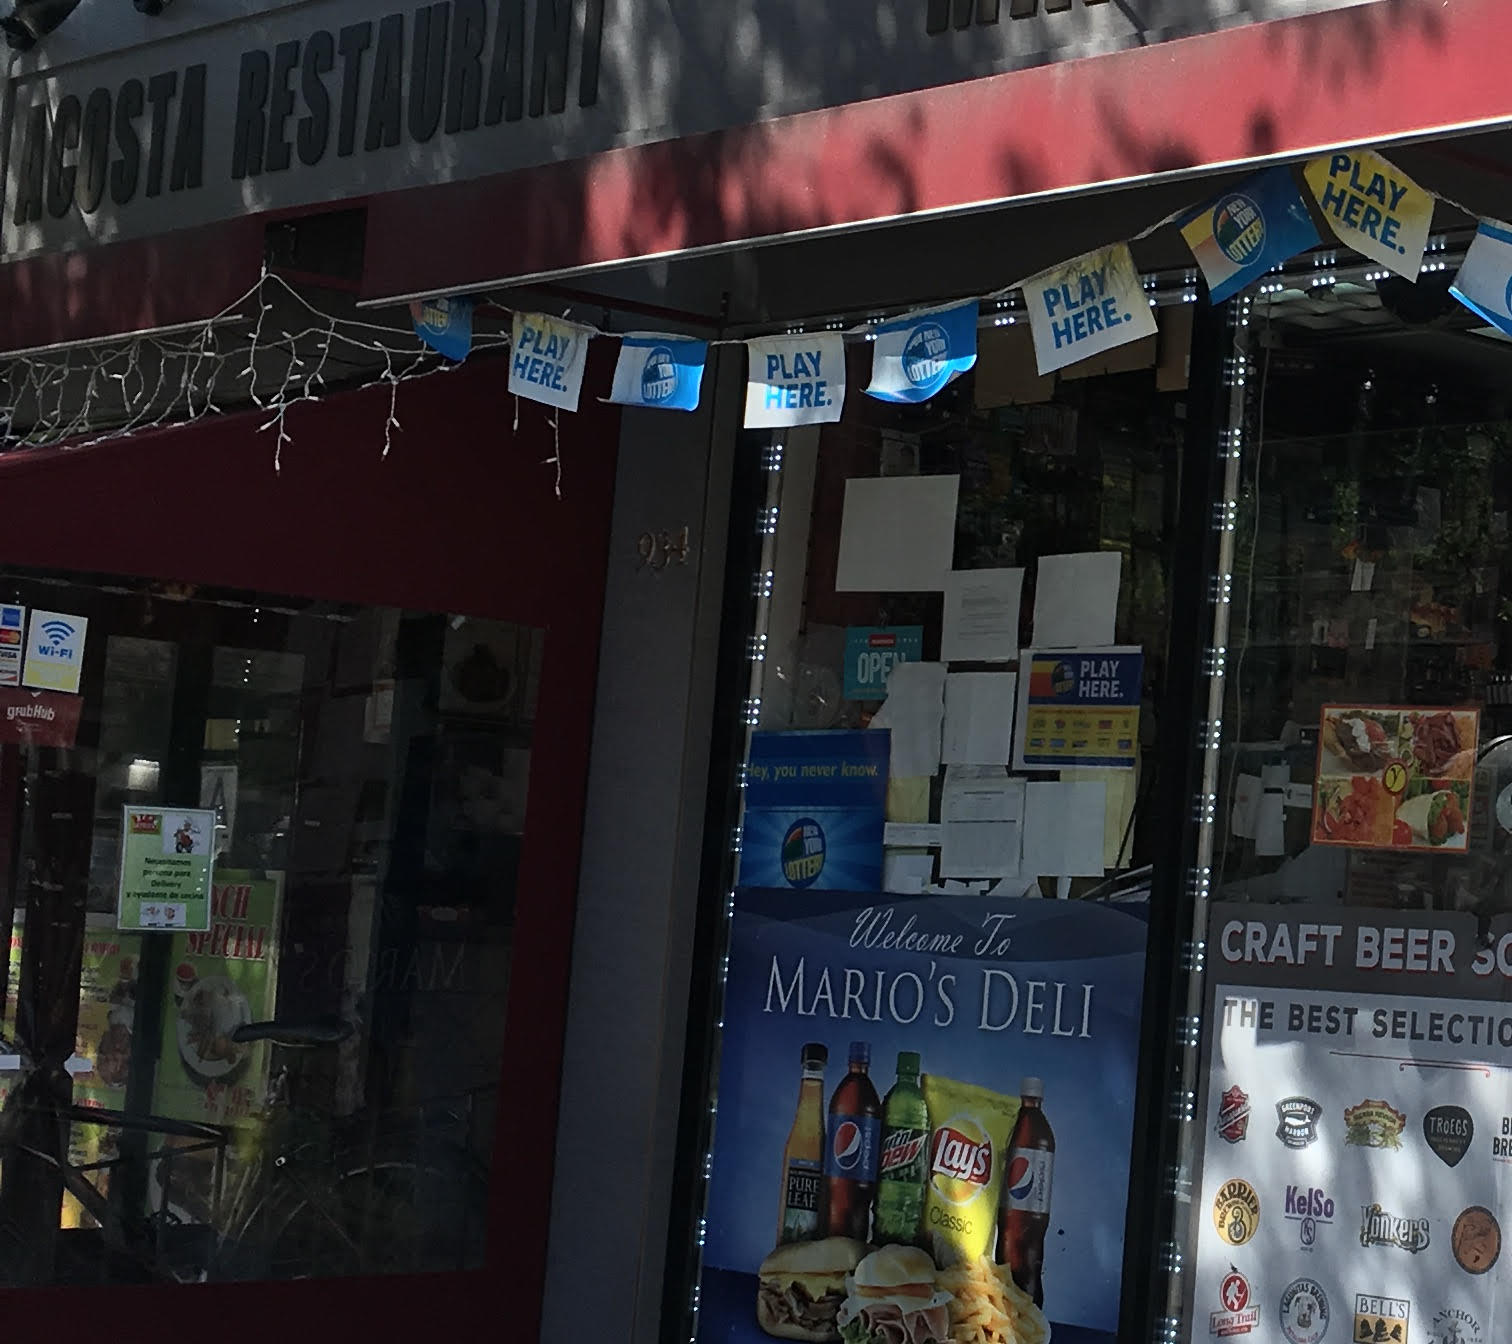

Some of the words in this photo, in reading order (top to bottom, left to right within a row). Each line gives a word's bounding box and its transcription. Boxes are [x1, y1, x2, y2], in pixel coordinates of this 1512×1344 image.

[14, 64, 207, 226] ACOSTA
[1329, 154, 1409, 212] PLAY
[1321, 181, 1407, 255] HERE.
[1042, 267, 1109, 320] PLAY
[1051, 296, 1133, 349] HERE.
[519, 325, 571, 362] PLAY
[512, 353, 569, 394] HERE.
[766, 349, 822, 381] PLAY
[764, 380, 834, 410] HERE.
[1079, 659, 1121, 680] PLAY
[1077, 679, 1125, 699] HERE.
[773, 765, 797, 782] you
[800, 764, 836, 778] never
[840, 760, 880, 778] know.
[186, 923, 267, 960] SPECIAL
[848, 907, 965, 956] Welcome
[973, 912, 1017, 957] To
[1220, 919, 1344, 967] CRAFT
[1355, 926, 1456, 975] BEER
[763, 955, 958, 1029] MARIO'S
[977, 968, 1096, 1040] DELI
[1222, 997, 1275, 1031] THE
[1287, 1002, 1360, 1037] BEST
[1429, 1116, 1469, 1138] TROEGS
[932, 1130, 991, 1180] Lay's
[786, 1190, 817, 1209] LEAF
[788, 1175, 821, 1194] PURE
[1214, 1180, 1261, 1218] BARRIER
[1284, 1185, 1335, 1219] KelSo
[929, 1206, 974, 1235] Classic
[1360, 1205, 1431, 1254] Yonkers
[1358, 1296, 1406, 1320] BELL'S
[1431, 1308, 1482, 1336] ANCHOR
